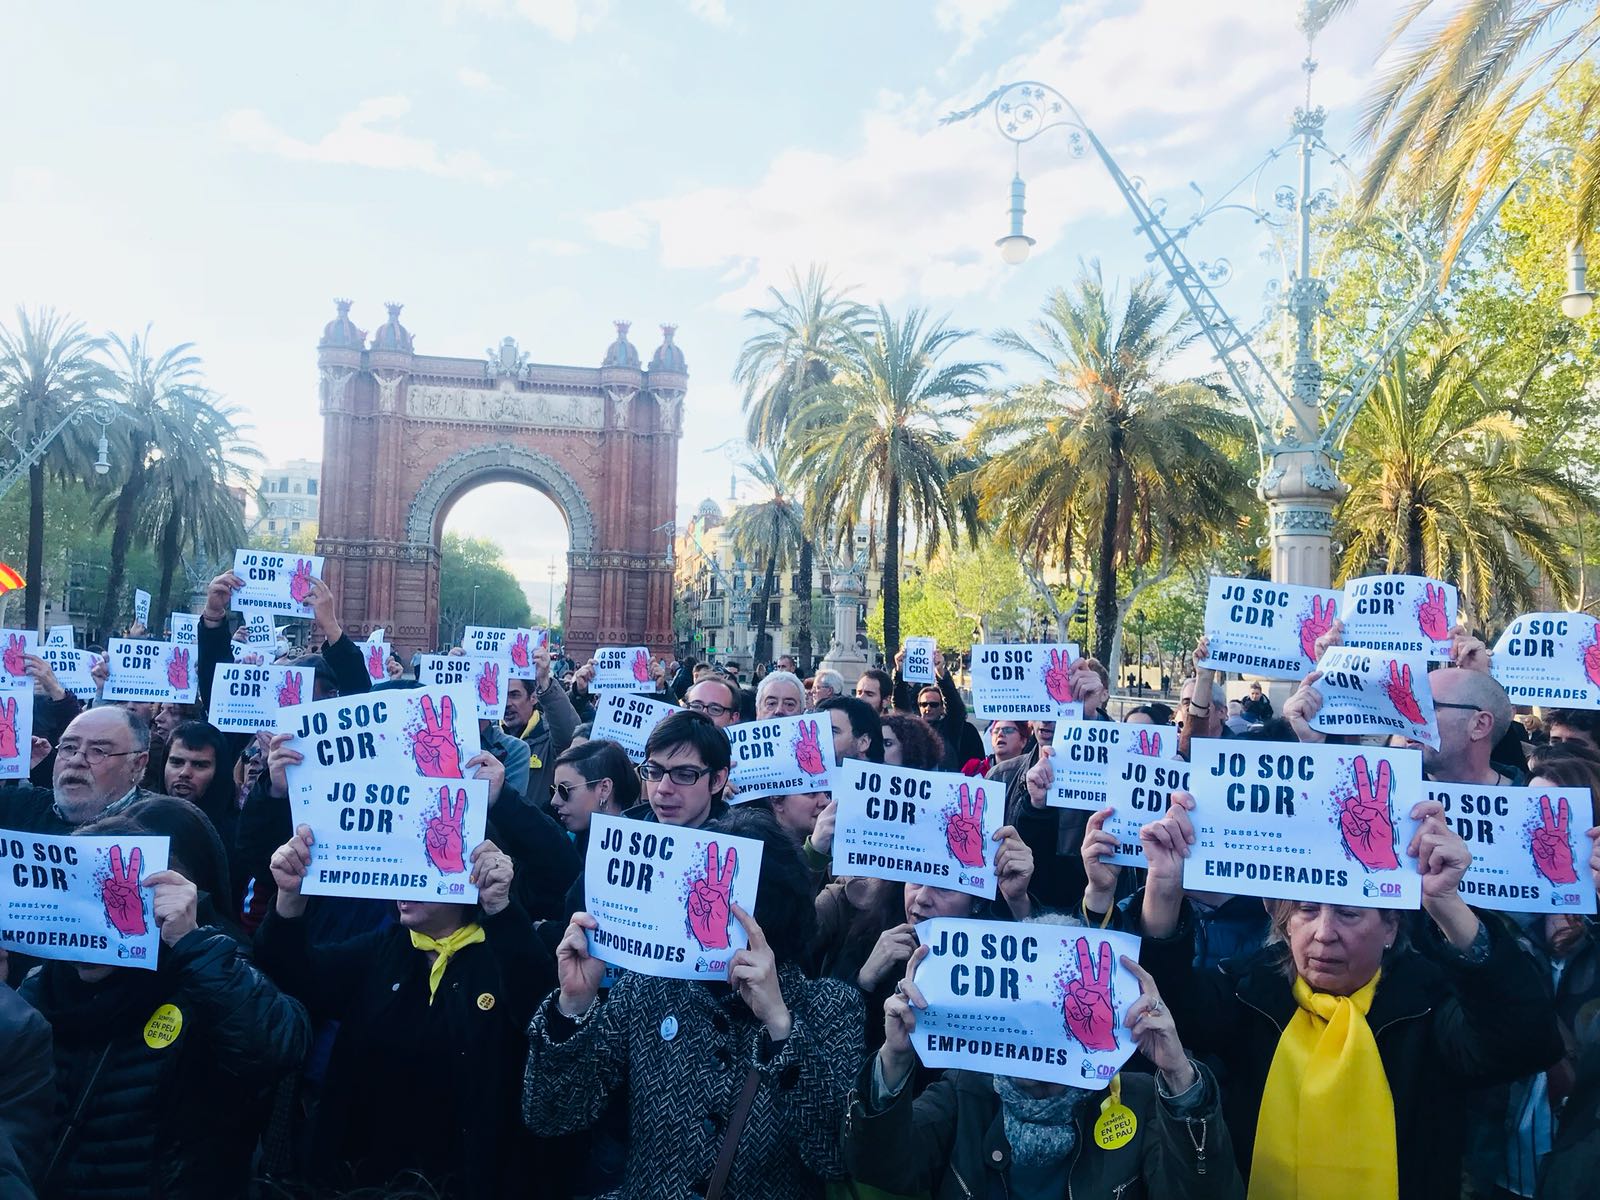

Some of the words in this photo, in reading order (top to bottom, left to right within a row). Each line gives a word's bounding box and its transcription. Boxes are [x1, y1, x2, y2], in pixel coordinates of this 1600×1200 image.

[243, 555, 257, 565] JO
[261, 556, 284, 568] SOC
[249, 568, 276, 582] CDR
[1222, 586, 1245, 601] JO
[1252, 588, 1289, 607] SOC
[1352, 584, 1367, 597] JO
[1374, 582, 1405, 596] SOC
[238, 599, 291, 609] EMPODERADES
[1357, 598, 1394, 615] CDR
[251, 616, 264, 624] JO
[1231, 605, 1274, 628] CDR
[248, 625, 270, 633] SOC
[1512, 622, 1522, 634] O
[1529, 620, 1567, 636] SOC
[249, 634, 270, 643] CDR
[472, 631, 483, 639] JO
[487, 632, 505, 640] SOC
[116, 644, 131, 654] JO
[136, 645, 159, 656] SOC
[476, 641, 498, 651] CDR
[913, 648, 926, 656] JO
[1509, 639, 1554, 658] CDR
[43, 651, 59, 660] JO
[61, 651, 80, 660] SOC
[909, 657, 929, 665] SOC
[981, 651, 999, 663] JO
[1005, 650, 1032, 663] SOC
[1212, 651, 1300, 671] EMPODERADES
[51, 661, 76, 671] CDR
[122, 657, 151, 670] CDR
[429, 661, 443, 670] JO
[448, 661, 470, 671] SOC
[600, 661, 620, 669] CDR
[909, 666, 928, 674] CDR
[1343, 654, 1370, 673] SOC
[223, 669, 239, 680] JO
[244, 670, 269, 681] SOC
[435, 673, 462, 684] CDR
[991, 666, 1025, 681] CDR
[1325, 671, 1363, 691] CDR
[112, 687, 169, 696] EMPODERADES
[230, 683, 260, 697] CDR
[1502, 686, 1587, 699] MPODERADES
[609, 696, 625, 708] JO
[629, 700, 653, 715] SOC
[983, 704, 1050, 713] EMPODERADES
[218, 718, 278, 727] EMPODERADE
[297, 712, 327, 738] JO
[338, 702, 388, 730] SOC
[613, 710, 642, 729] CDR
[1319, 715, 1405, 729] EMPODERADES
[730, 730, 746, 743] JO
[753, 725, 781, 740] SOC
[1064, 727, 1082, 741] JO
[1088, 727, 1119, 744] SOC
[316, 732, 376, 766] CDR
[740, 742, 774, 760] CDR
[1071, 744, 1108, 764] CDR
[1122, 762, 1147, 783] JO
[1211, 753, 1246, 777] JO
[1258, 754, 1314, 781] SOC
[735, 778, 803, 794] MPODERADES
[855, 772, 881, 792] JO
[890, 776, 932, 800] SOC
[327, 782, 356, 803] JO
[365, 784, 410, 805] SOC
[1058, 789, 1106, 803] EMPODER
[1226, 783, 1296, 817] CDR
[866, 797, 916, 825] CDR
[1461, 794, 1509, 816] SOC
[340, 807, 393, 833] CDR
[863, 829, 905, 840] passives
[1223, 827, 1282, 839] passives
[336, 843, 382, 852] passives
[600, 828, 623, 852] JO
[629, 832, 675, 861] SOC
[1201, 840, 1215, 848] ni
[1224, 841, 1312, 855] terroristes:
[32, 843, 78, 865] SOC
[336, 854, 403, 863] terroristes:
[848, 852, 949, 876] EMPODERADES
[13, 864, 68, 892] CDR
[320, 870, 428, 887] EMPODERADES
[607, 858, 654, 894] CDR
[970, 876, 984, 885] CDR
[1205, 860, 1348, 887] EMPODERADES
[449, 883, 464, 892] CDR
[1380, 883, 1401, 894] CDR
[1458, 881, 1540, 899] ODERADES
[9, 902, 59, 910] passives
[602, 900, 638, 913] passives
[9, 913, 81, 923] terroristes:
[603, 912, 659, 931] terroristes:
[131, 946, 146, 956] CDR
[594, 928, 686, 963] EMPODERADES
[932, 931, 969, 957] JO
[981, 933, 1038, 963] SOC
[709, 960, 727, 969] CDR
[950, 964, 1020, 1001] CDR
[947, 1012, 1006, 1022] passives
[162, 1023, 175, 1032] PEU
[924, 1019, 937, 1027] ni
[947, 1021, 1034, 1036] terroristes:
[148, 1030, 157, 1038] DE
[158, 1033, 172, 1041] PAU
[927, 1034, 1068, 1066] EMPODERADES
[1096, 1064, 1116, 1076] CDR
[1103, 1113, 1125, 1127] SEMPRE
[1101, 1127, 1112, 1136] EN
[1114, 1119, 1131, 1130] PEU
[1103, 1135, 1114, 1144] DE
[1116, 1127, 1132, 1138] PAU
